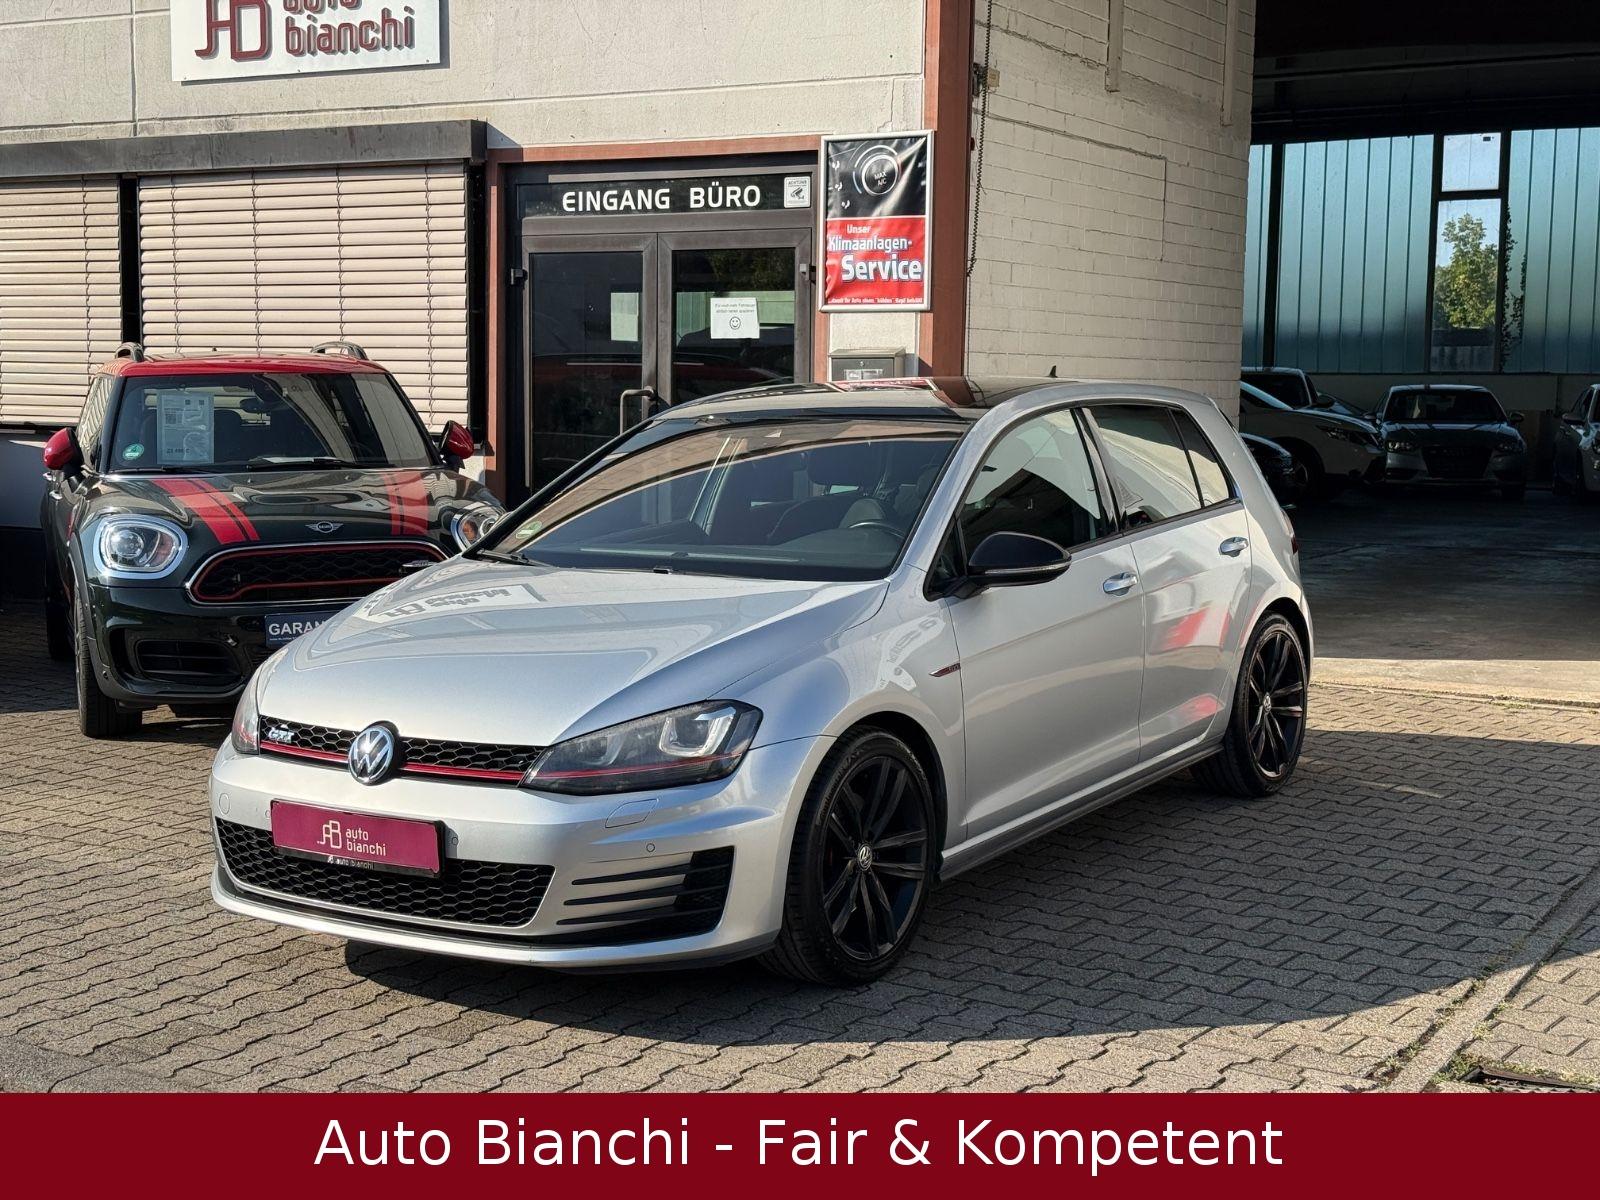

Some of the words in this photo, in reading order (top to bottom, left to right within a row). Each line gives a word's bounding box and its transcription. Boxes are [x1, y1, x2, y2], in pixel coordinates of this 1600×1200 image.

[285, 7, 414, 57] bianchi
[874, 171, 887, 180] MAX
[562, 187, 671, 212] EINGANG
[689, 181, 761, 209] BÜRO
[846, 224, 871, 234] Unser
[827, 234, 912, 253] Klimaanlagen-
[841, 253, 922, 281] Service
[268, 727, 295, 743] GTI
[345, 828, 369, 841] auto
[346, 839, 387, 857] bianchi
